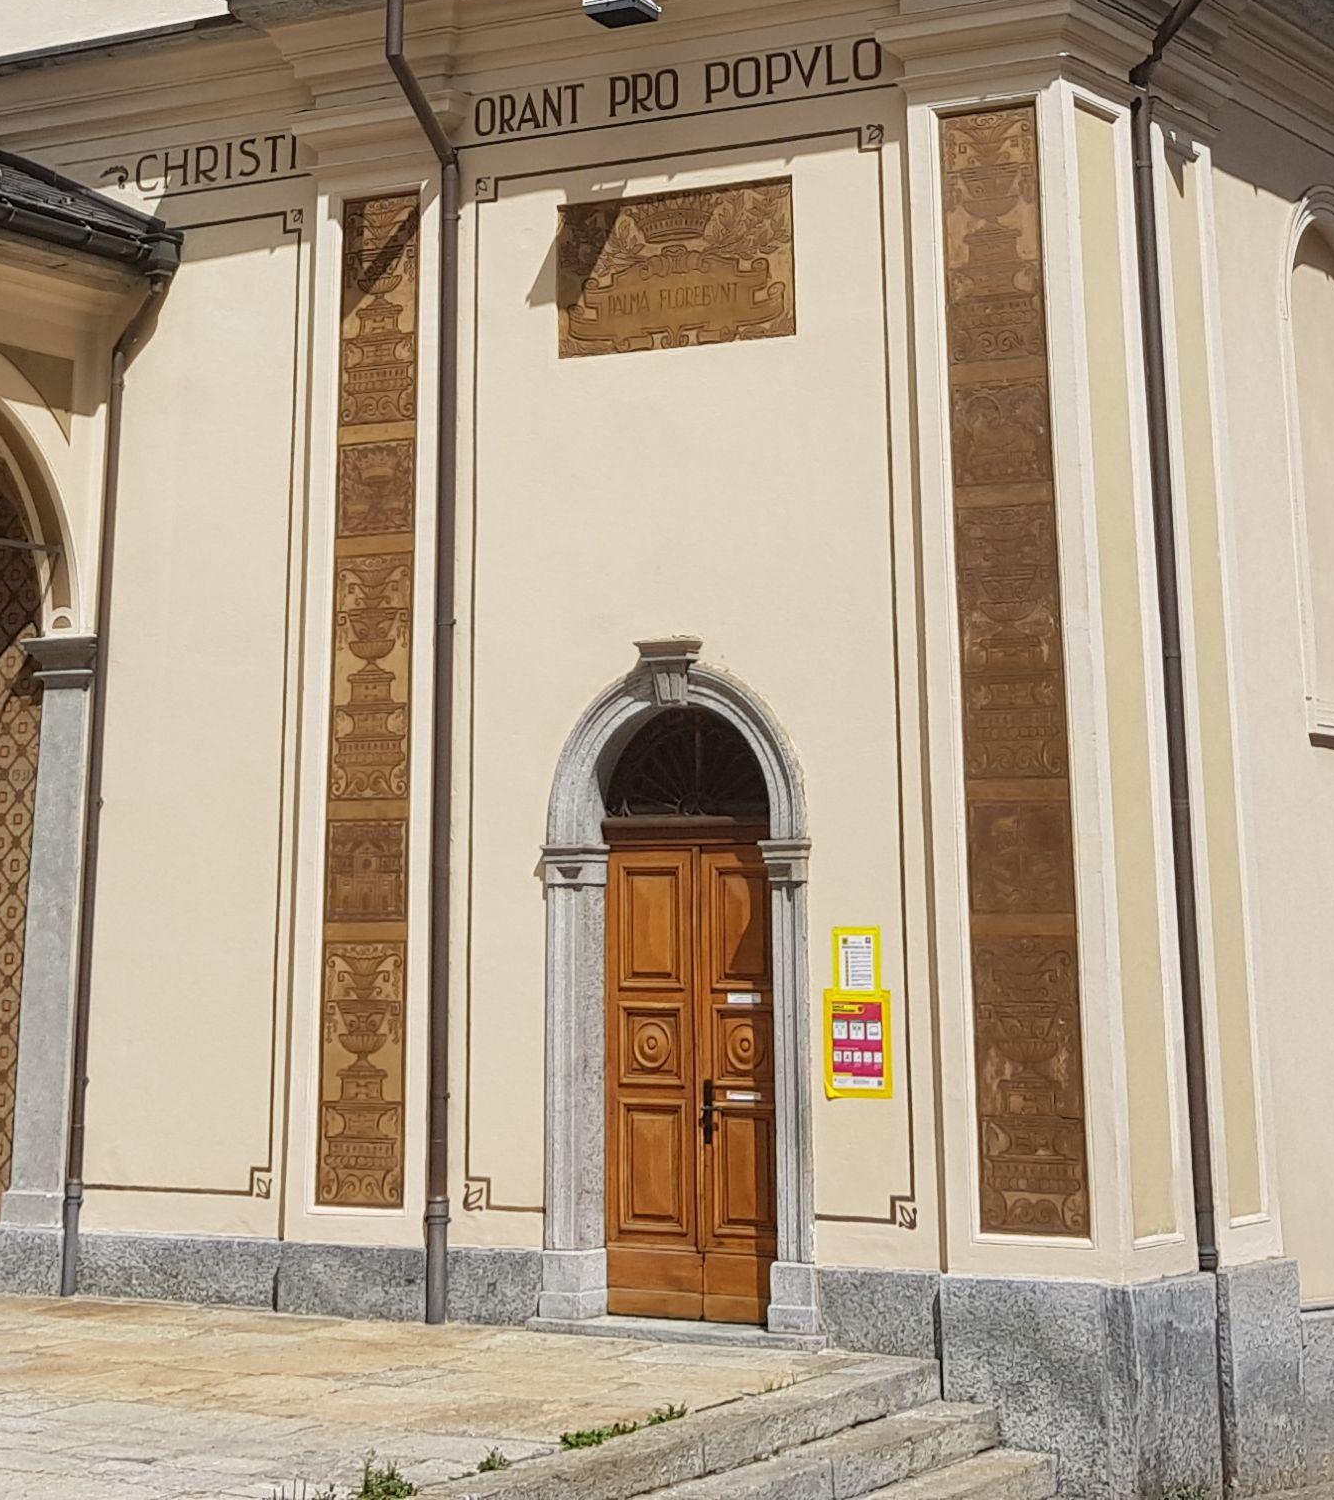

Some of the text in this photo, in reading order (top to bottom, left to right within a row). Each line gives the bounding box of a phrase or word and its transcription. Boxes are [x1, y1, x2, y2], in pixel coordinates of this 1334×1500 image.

[474, 37, 882, 137] ORANT PRO POPVLO
[135, 133, 297, 193] CHRISTI
